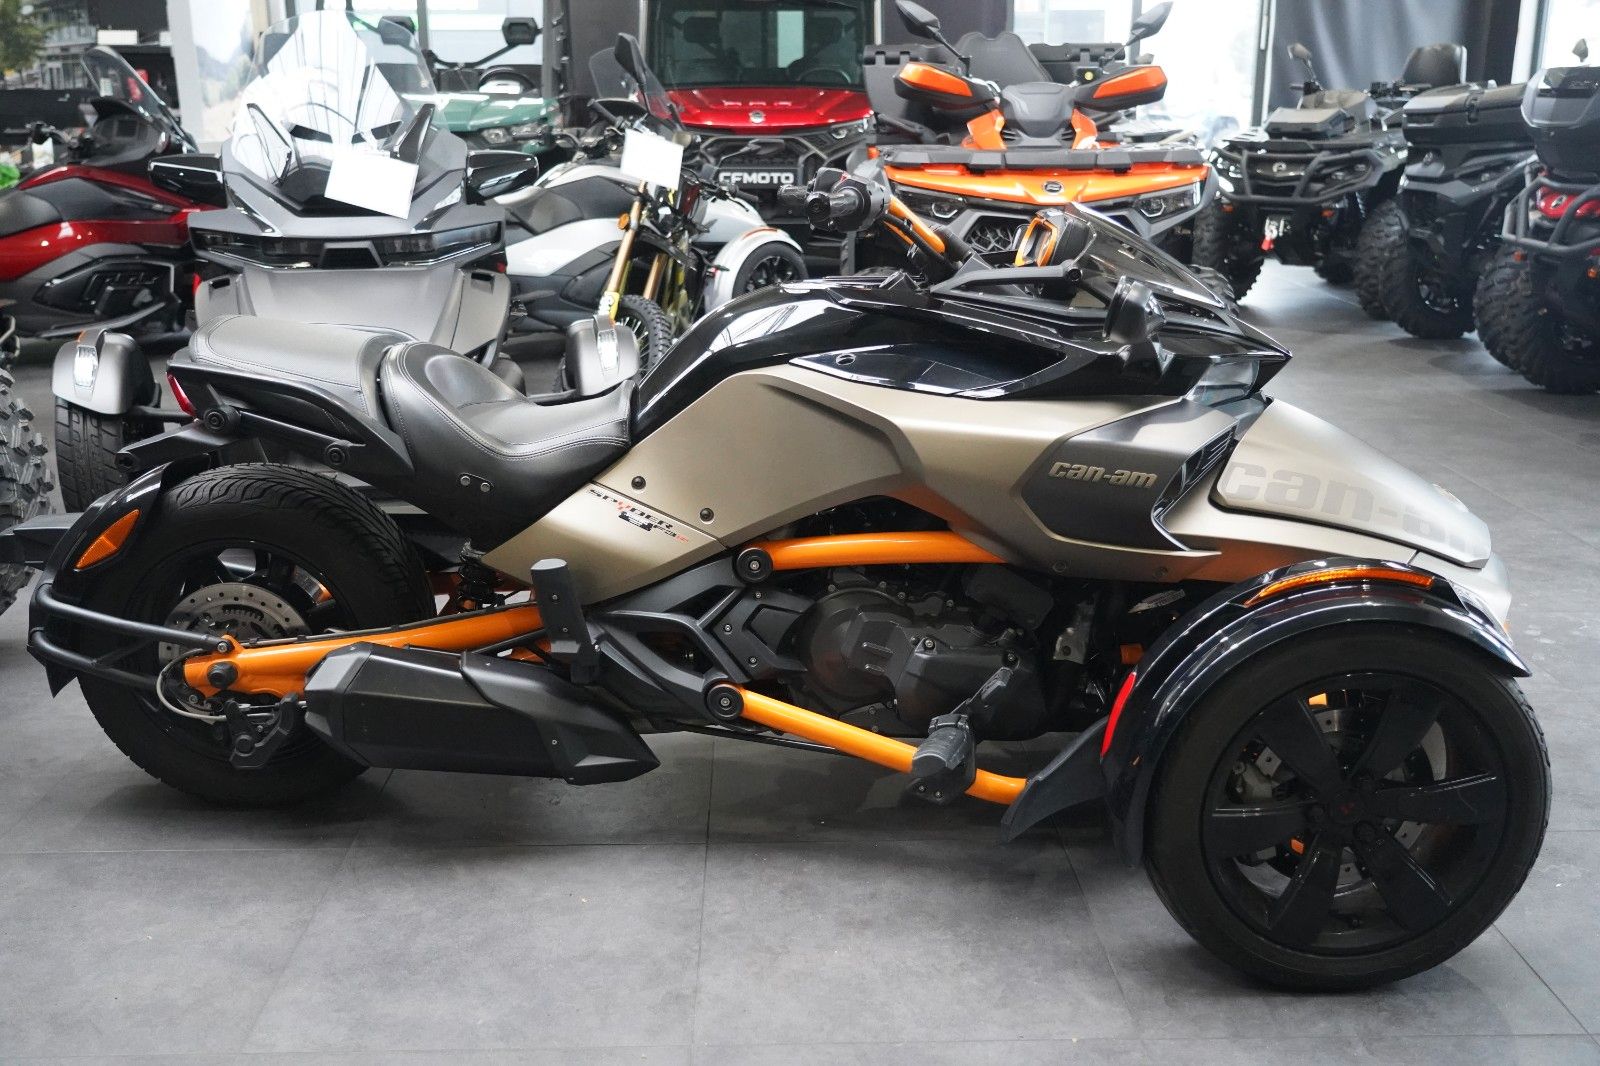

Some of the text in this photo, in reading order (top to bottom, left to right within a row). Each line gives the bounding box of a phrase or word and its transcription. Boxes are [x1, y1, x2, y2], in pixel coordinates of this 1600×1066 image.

[718, 171, 795, 185] CFMOTO
[1048, 461, 1158, 489] can-am
[587, 488, 674, 531] SPYDER
